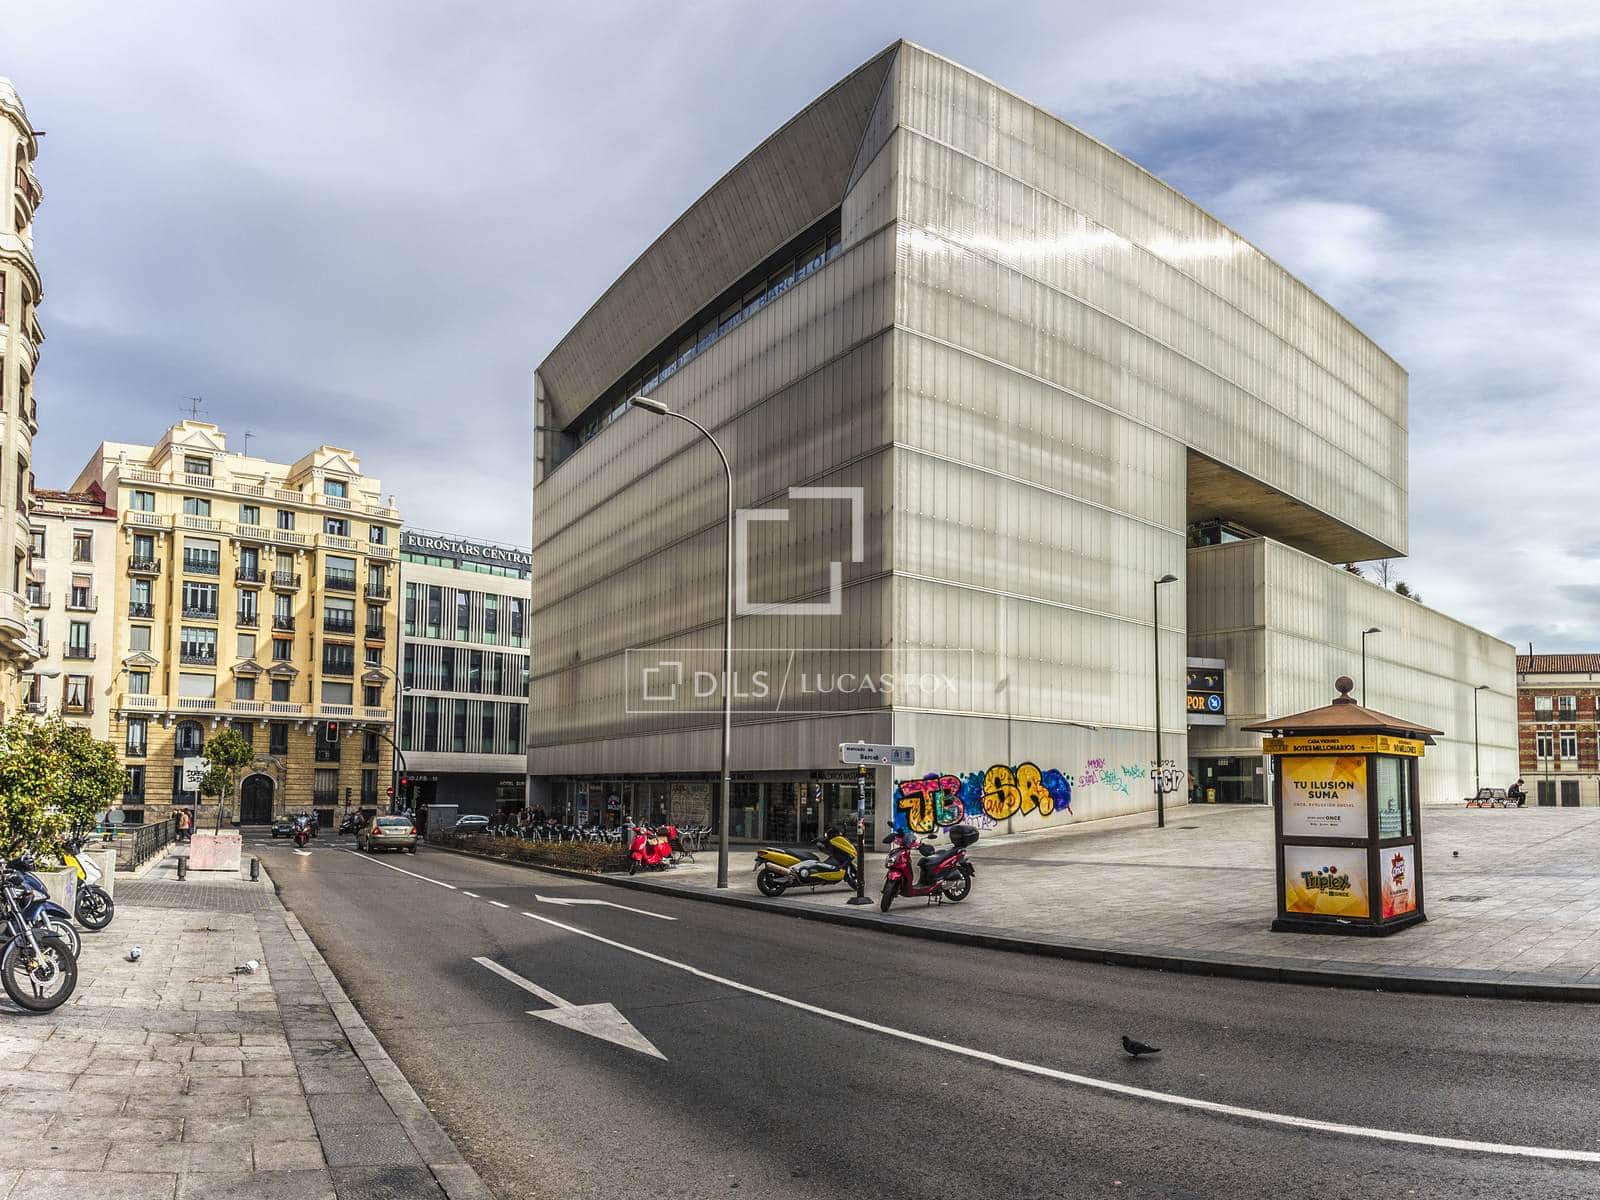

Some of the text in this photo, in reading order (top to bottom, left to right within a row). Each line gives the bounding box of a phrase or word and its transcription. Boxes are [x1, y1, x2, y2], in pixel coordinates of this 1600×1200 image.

[408, 535, 480, 556] EUROSTARS
[1293, 780, 1355, 790] TU ILUSIÓN
[1308, 790, 1340, 800] SUMA
